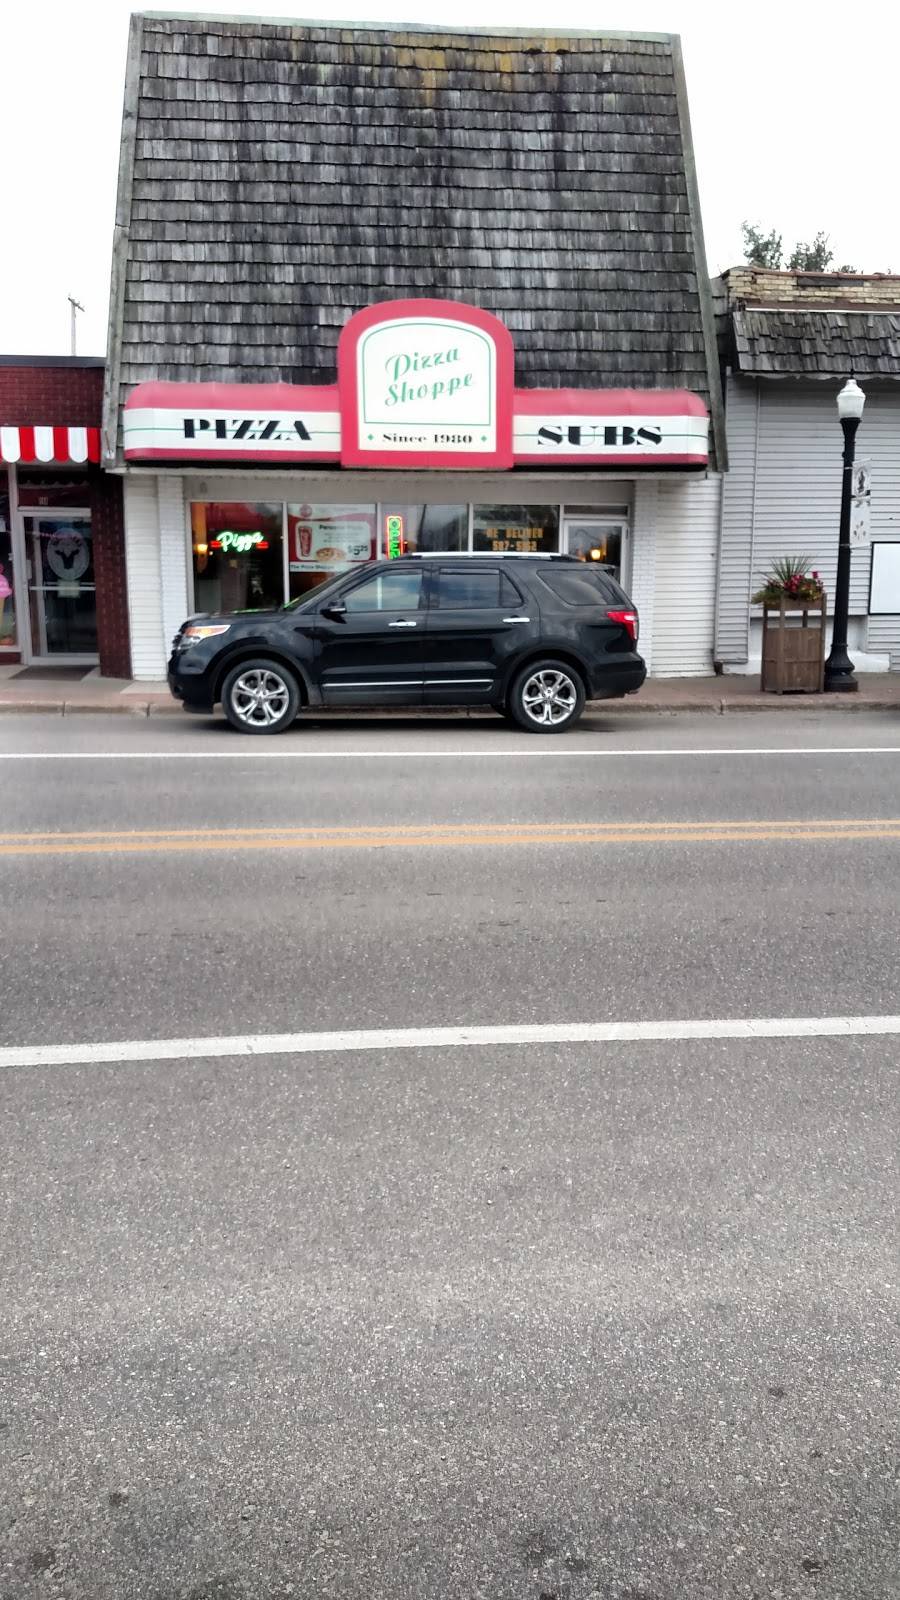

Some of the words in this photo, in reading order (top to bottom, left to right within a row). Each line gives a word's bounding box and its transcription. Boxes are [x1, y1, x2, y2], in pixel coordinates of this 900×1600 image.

[384, 346, 460, 381] Pizza
[384, 373, 475, 407] Shoppe
[183, 418, 312, 441] PIZZA
[382, 432, 427, 443] Since
[433, 434, 473, 444] 1980
[537, 424, 663, 447] SUBS
[216, 531, 264, 552] Pizza
[388, 517, 401, 560] OPEN
